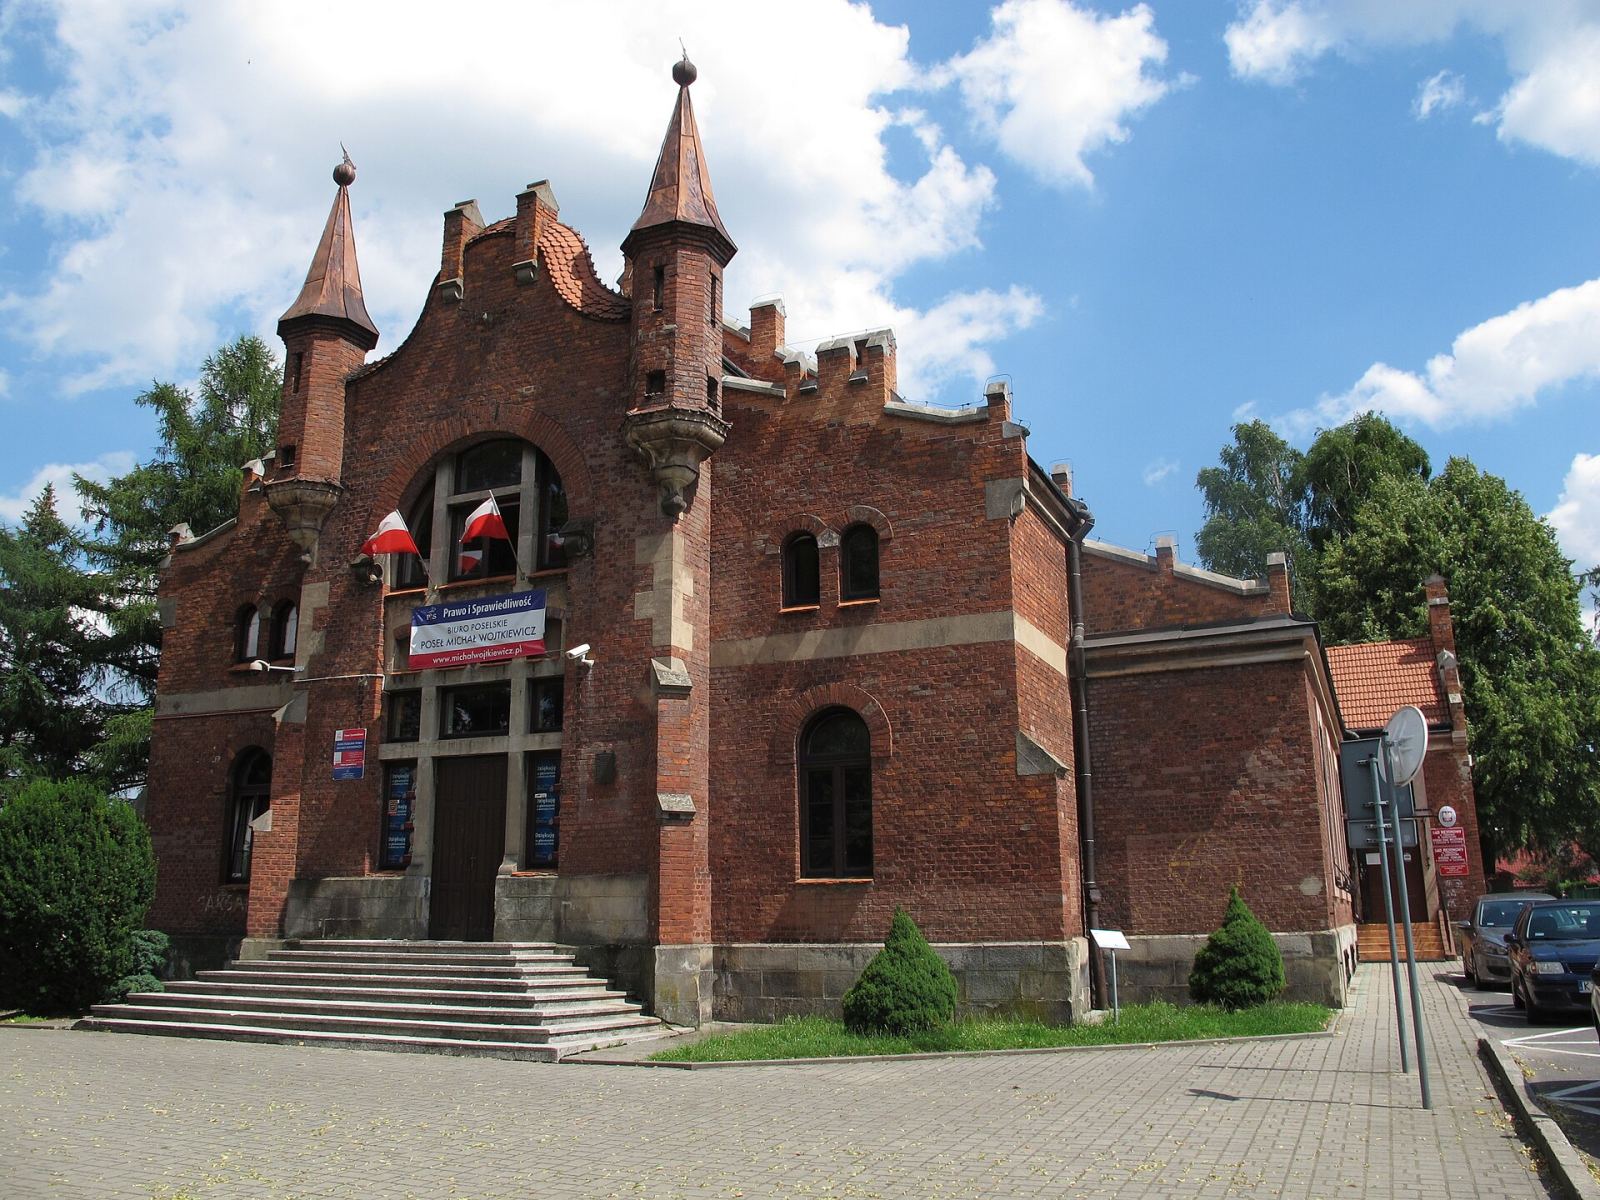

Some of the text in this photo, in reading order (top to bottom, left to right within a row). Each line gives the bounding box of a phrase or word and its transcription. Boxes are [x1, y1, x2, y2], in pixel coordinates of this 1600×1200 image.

[443, 607, 467, 618] Prawo
[472, 595, 532, 616] Sprawiedliwość
[447, 619, 508, 634] BIURO POSELSKIE
[420, 626, 537, 649] POSEŁ MICHAŁ WOJTKIEWICZ
[432, 644, 523, 664] www.michalwojtkiewicz.pl
